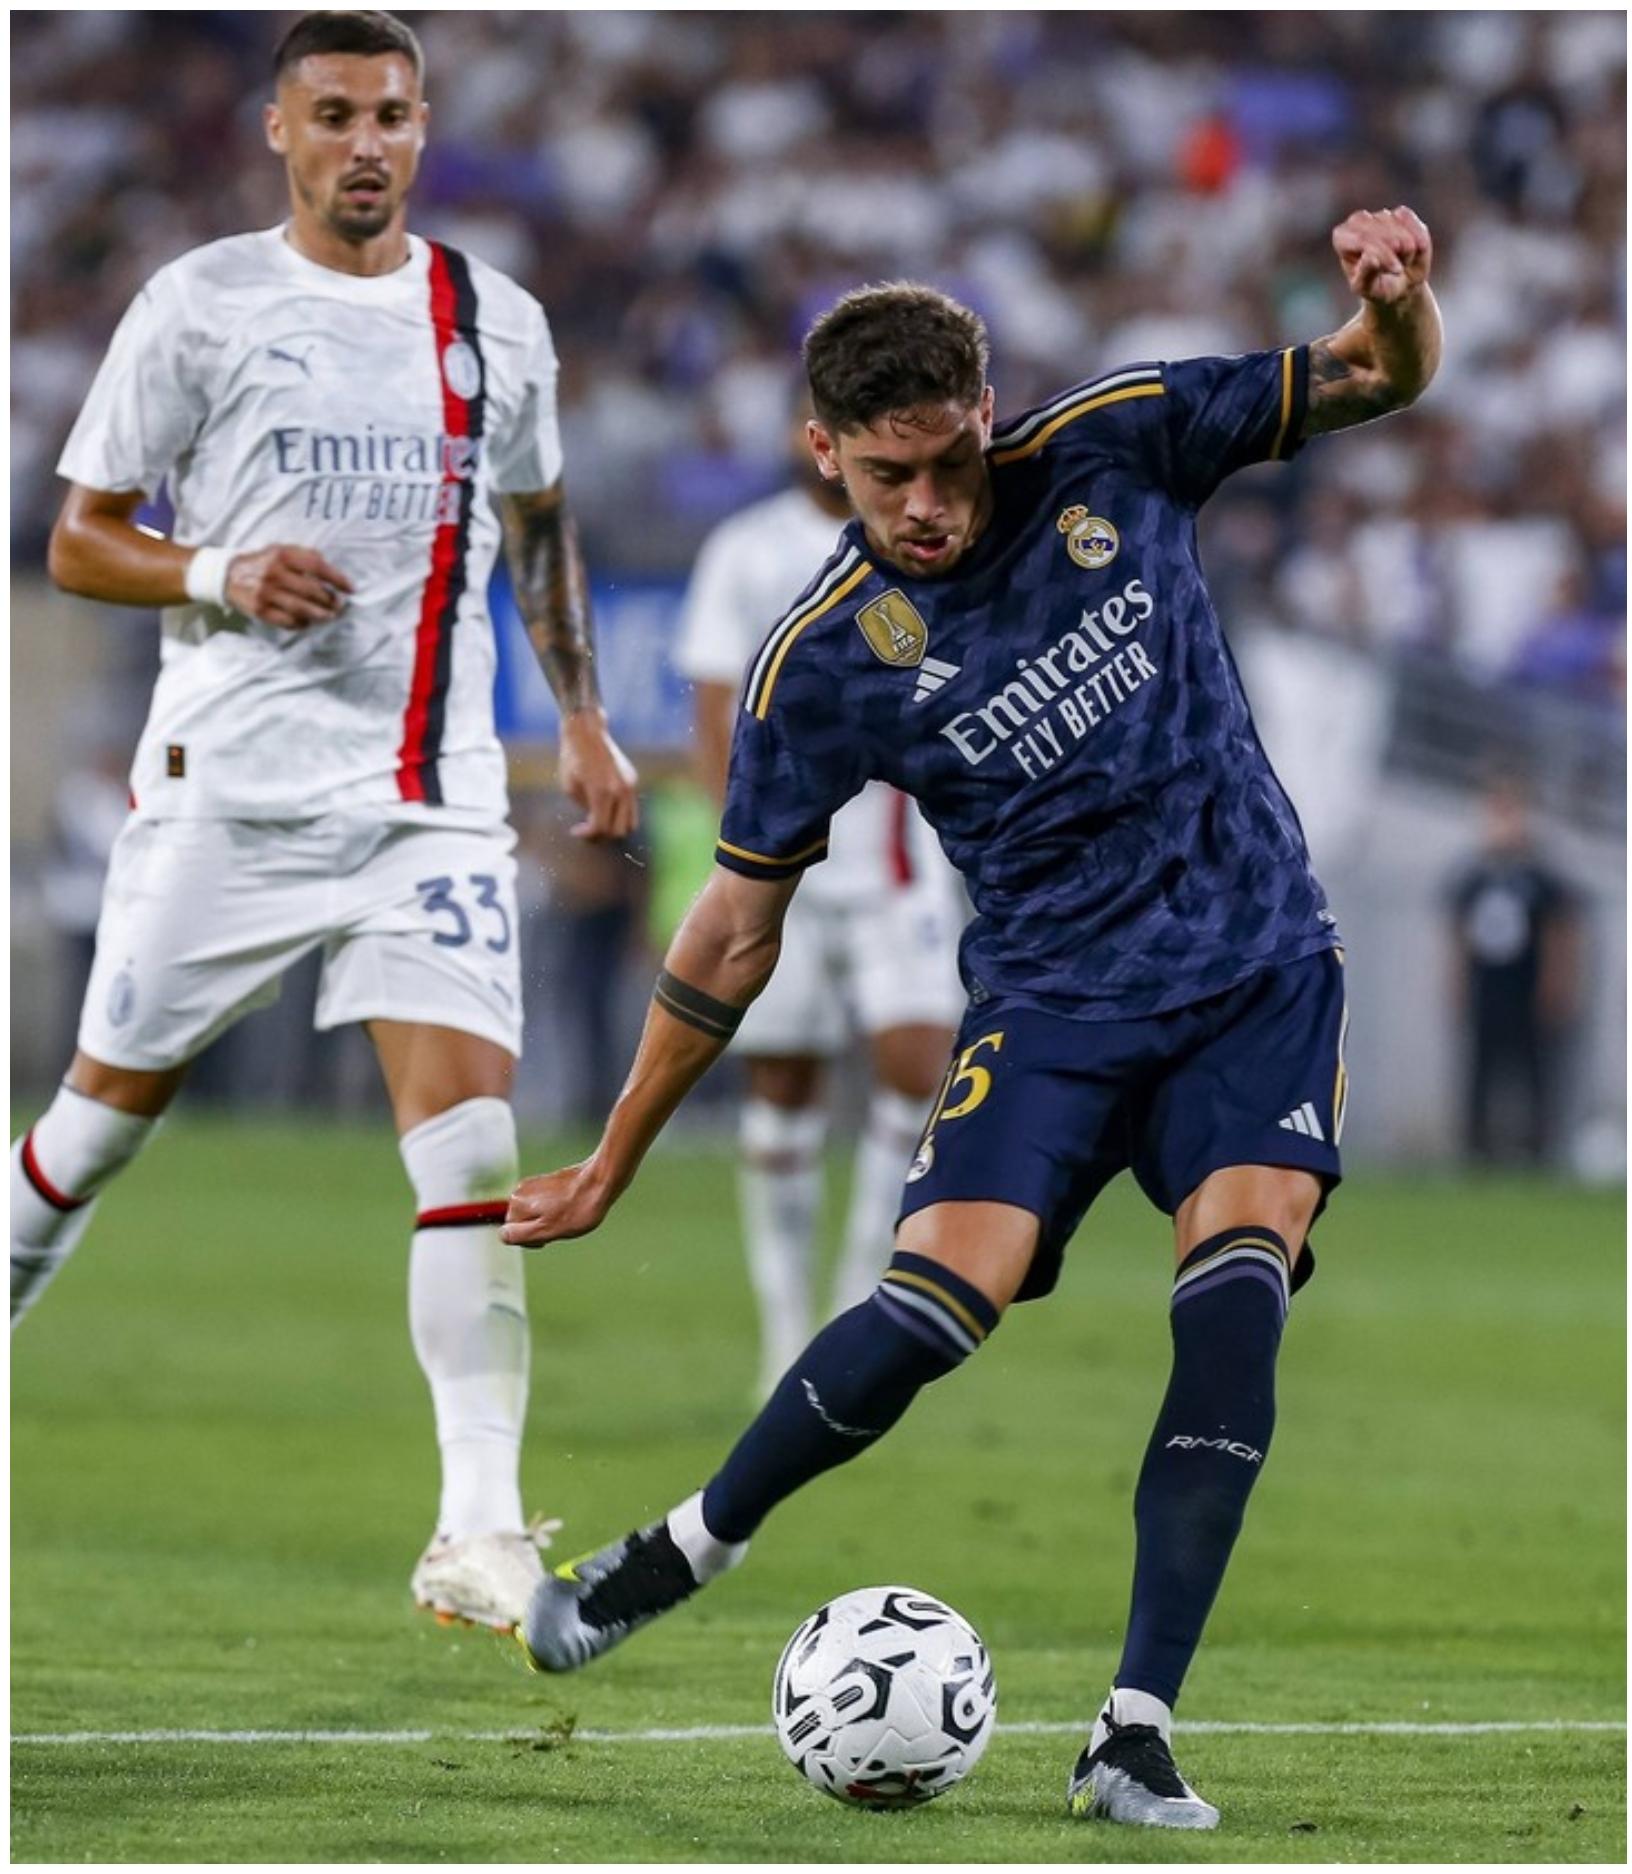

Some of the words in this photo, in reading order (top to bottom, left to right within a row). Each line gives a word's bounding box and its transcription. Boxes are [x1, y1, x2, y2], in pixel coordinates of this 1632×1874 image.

[305, 483, 357, 520] FLY
[937, 578, 1154, 767] Emirates
[1011, 714, 1064, 782] FLY
[1057, 641, 1158, 740] BETTER
[415, 873, 511, 954] 33
